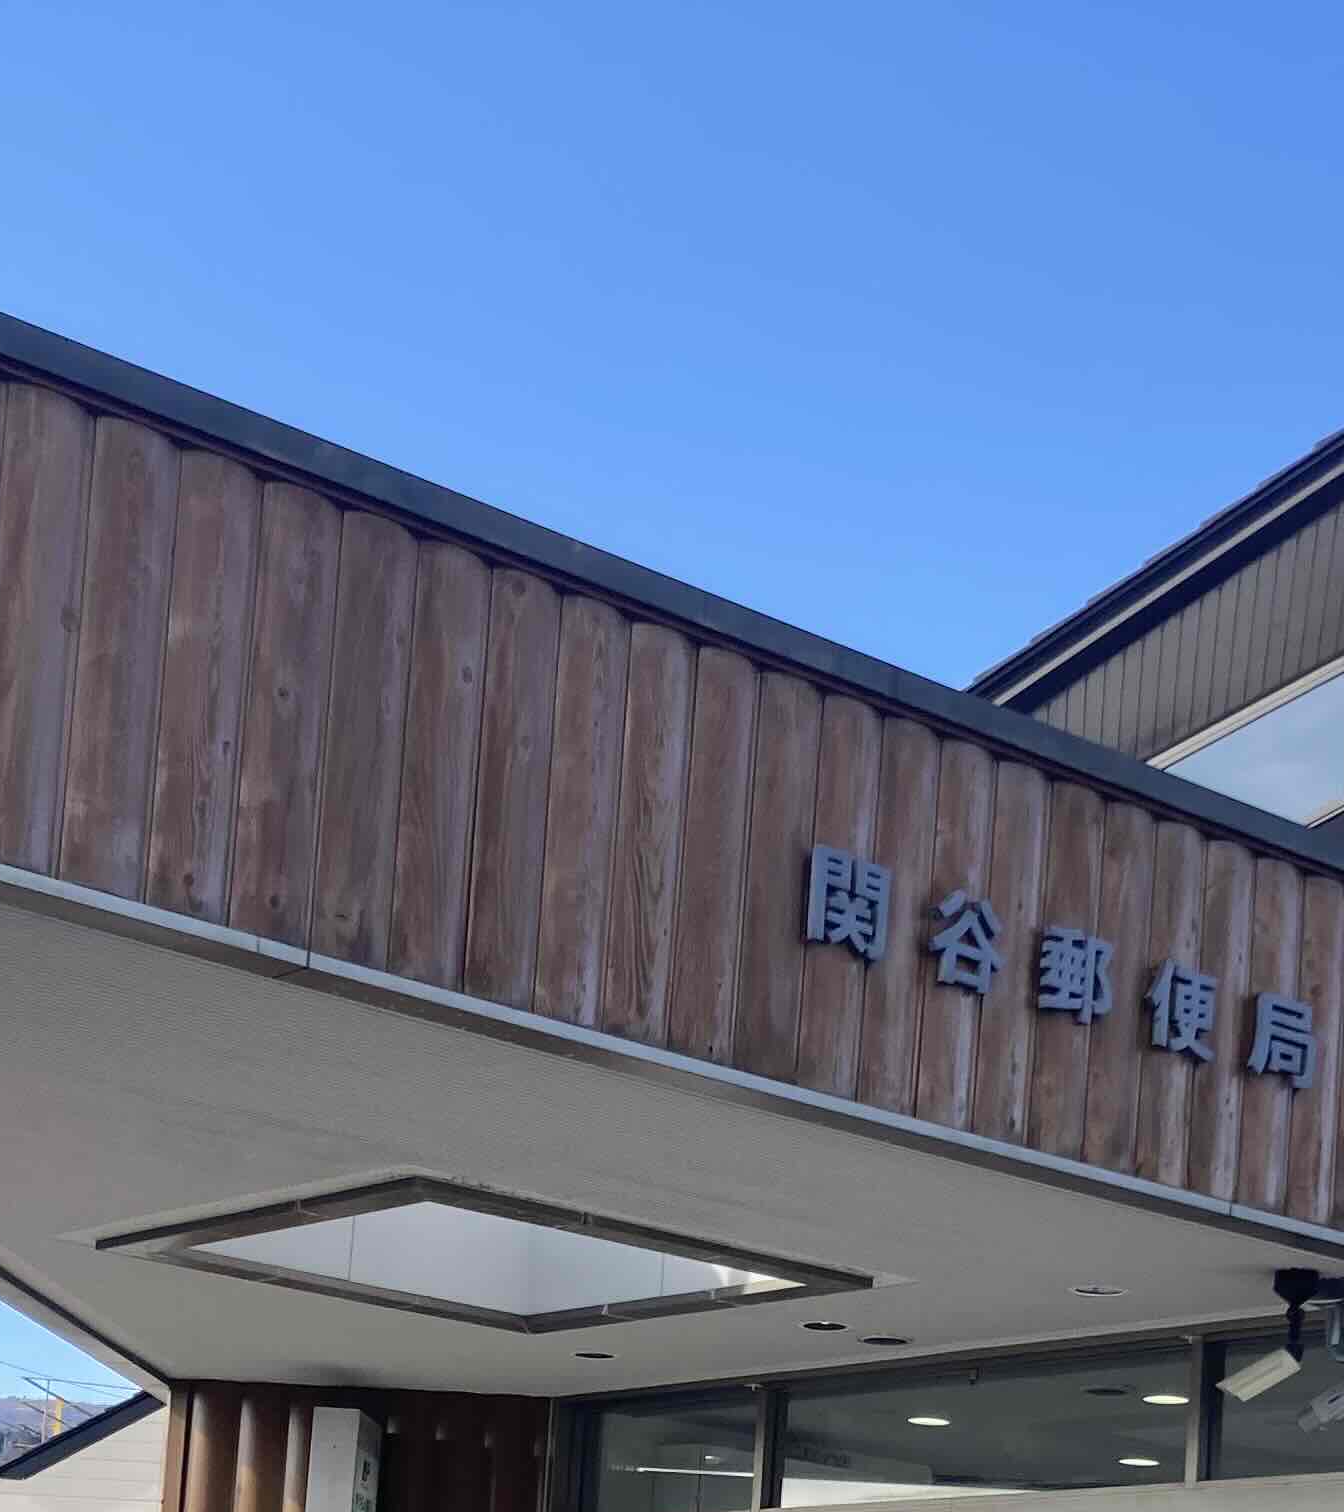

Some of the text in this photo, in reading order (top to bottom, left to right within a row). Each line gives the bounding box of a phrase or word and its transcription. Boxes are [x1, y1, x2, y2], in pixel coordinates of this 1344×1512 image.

[807, 844, 1316, 1089] 関谷郵便局
